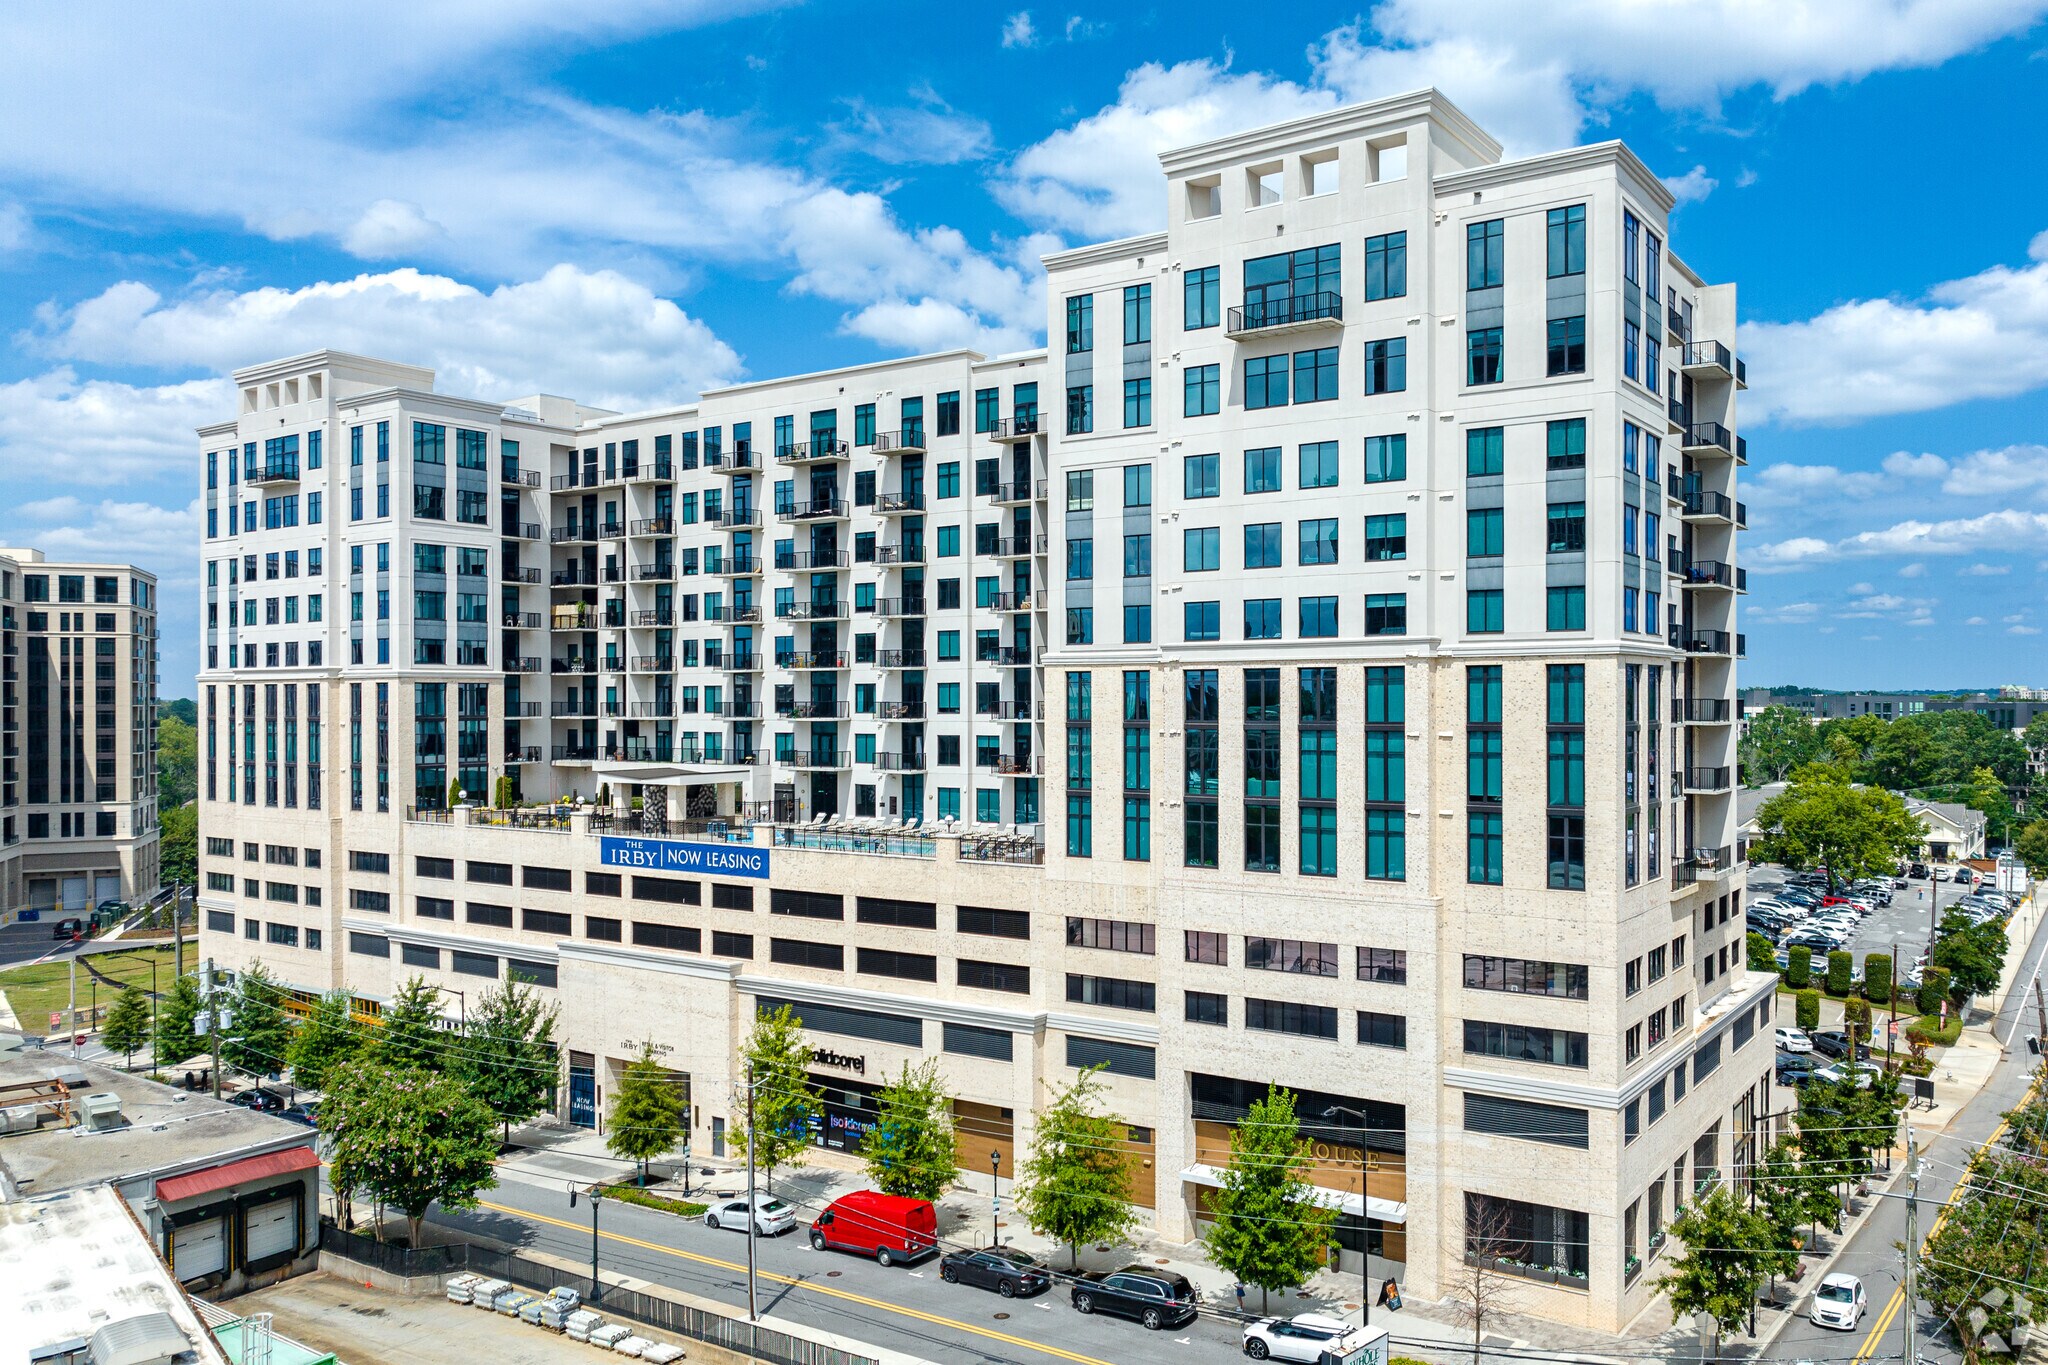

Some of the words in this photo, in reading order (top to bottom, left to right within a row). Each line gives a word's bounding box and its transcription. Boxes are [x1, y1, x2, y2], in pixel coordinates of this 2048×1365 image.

[625, 840, 644, 849] THE
[611, 849, 658, 867] IRBY
[667, 849, 702, 866] NOW
[706, 852, 762, 871] LEASING
[620, 1041, 638, 1051] IRBY
[659, 1044, 675, 1052] VISITOR
[571, 1101, 593, 1112] LEASING
